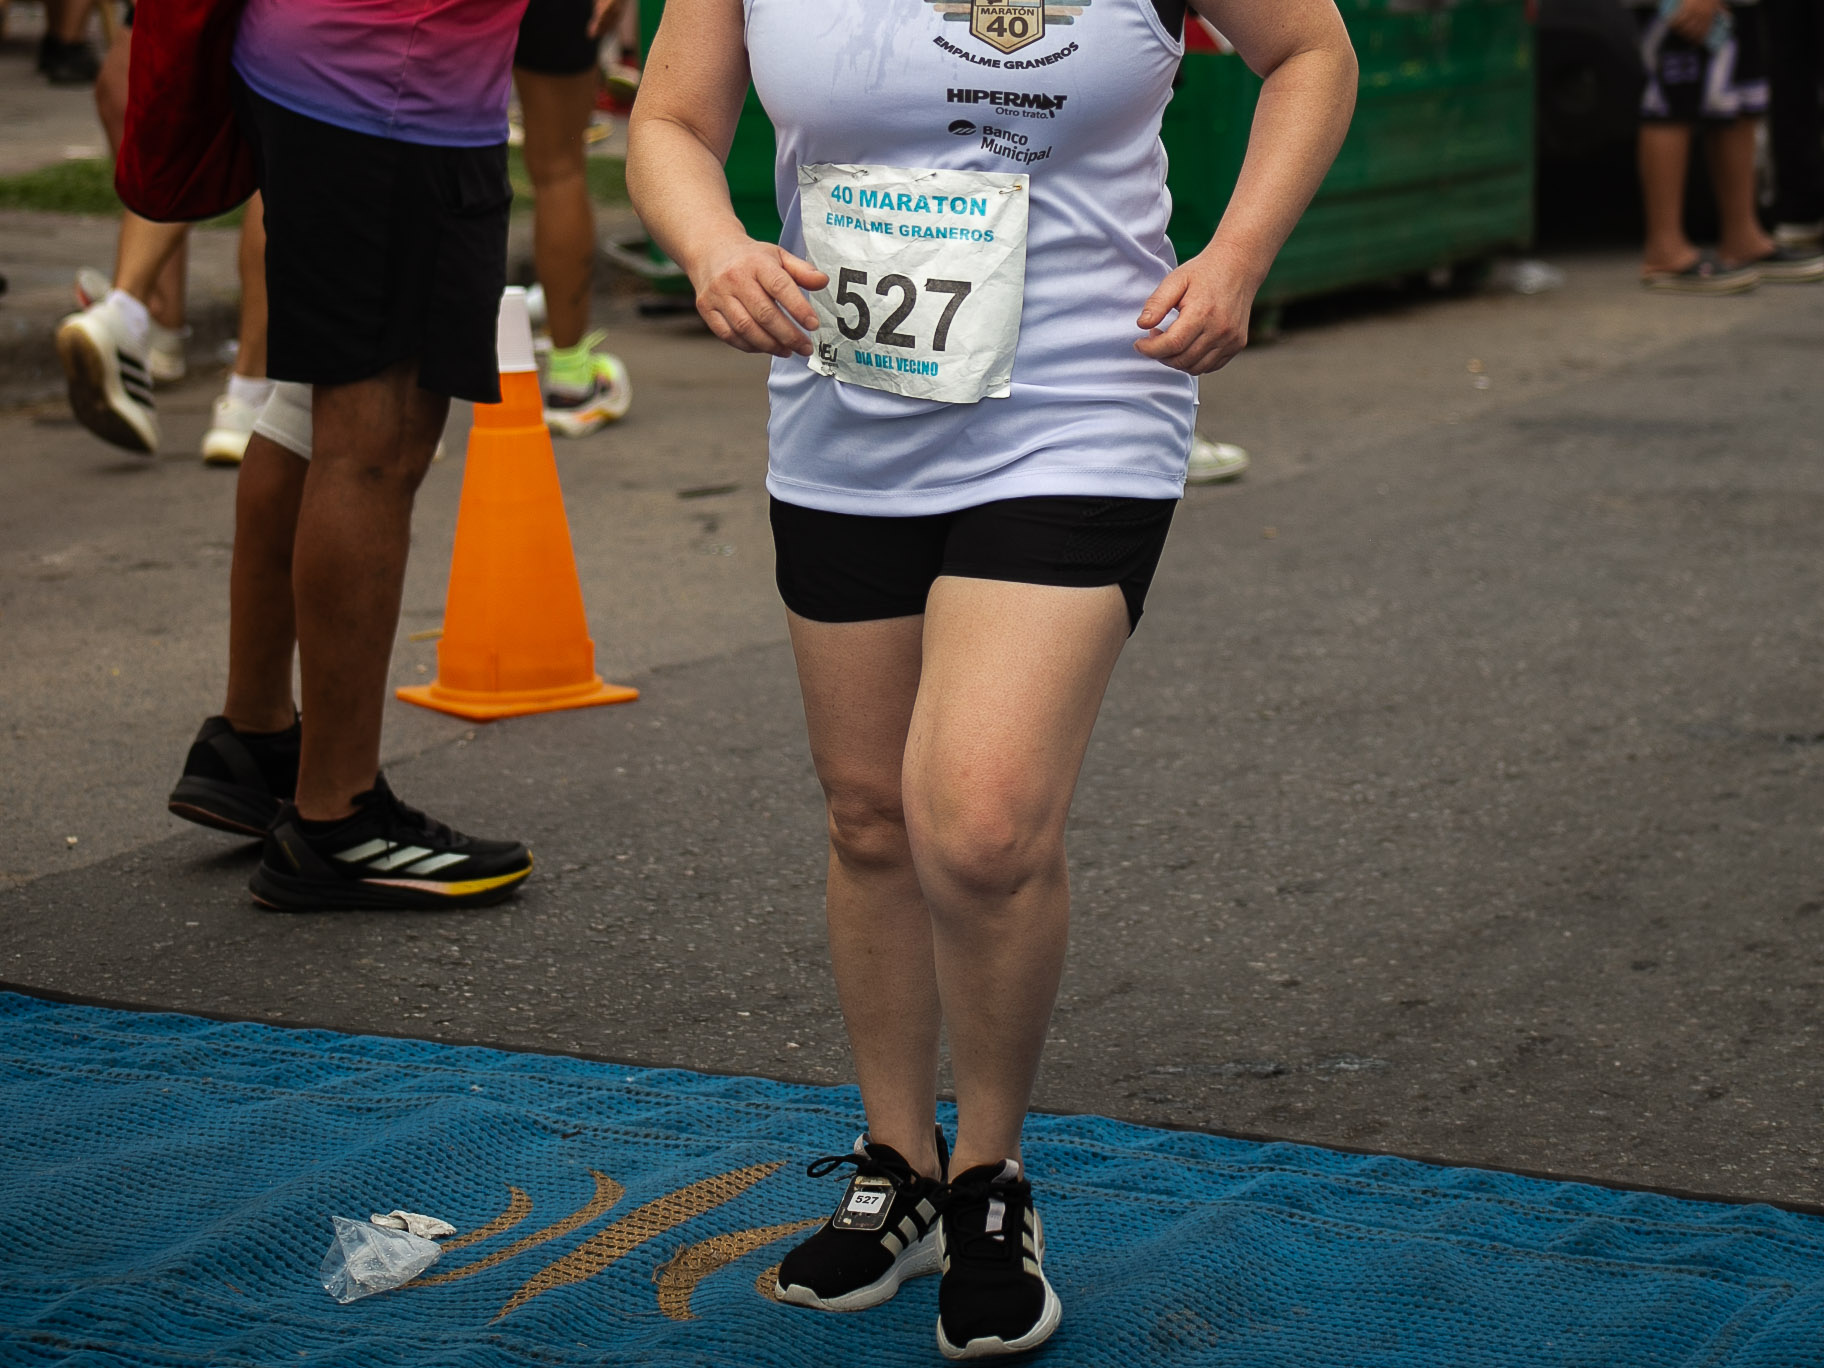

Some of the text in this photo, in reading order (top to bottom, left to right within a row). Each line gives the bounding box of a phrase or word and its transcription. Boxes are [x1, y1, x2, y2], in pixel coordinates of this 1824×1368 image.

[980, 6, 1035, 16] MARATÓN
[987, 16, 1029, 38] 40
[933, 36, 1079, 70] EMPALME GRANEROS
[995, 107, 1020, 116] Otro
[983, 125, 1029, 146] Banco
[980, 136, 1052, 165] Municipal
[831, 184, 988, 216] 40 MARATON
[826, 212, 994, 242] EMPALME GRANEROS
[836, 267, 972, 352] 527
[854, 349, 939, 376] DIA DEL VECINO
[855, 1195, 879, 1204] 527
